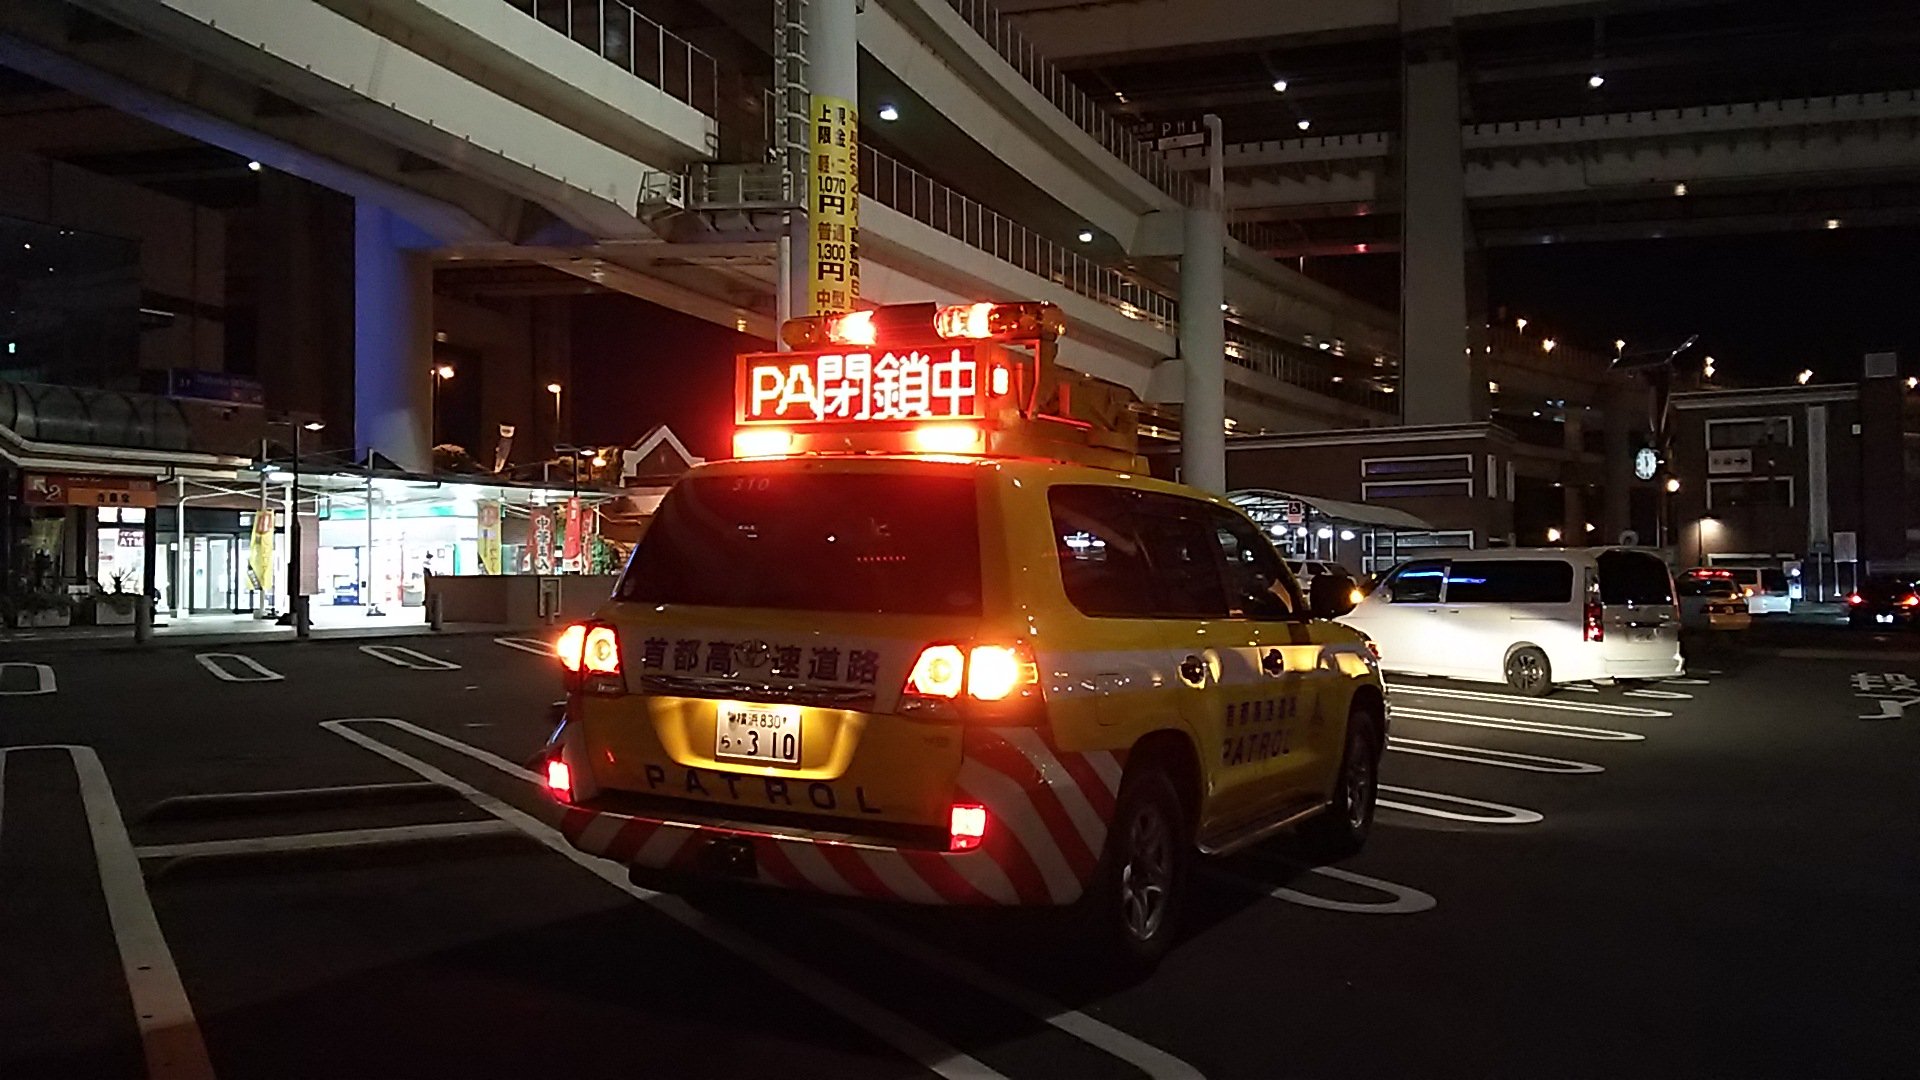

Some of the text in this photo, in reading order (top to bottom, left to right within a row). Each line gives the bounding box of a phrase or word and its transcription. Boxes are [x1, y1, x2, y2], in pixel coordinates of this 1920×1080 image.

[817, 103, 831, 145] 上限
[819, 195, 845, 216] 円
[817, 221, 845, 243] 普通
[818, 262, 844, 282] 円
[816, 289, 845, 309] 中型
[750, 348, 977, 421] PA閉鎖中
[732, 477, 770, 492] 310
[641, 637, 880, 685] 首都高速道路
[1222, 730, 1290, 765] PATROL
[644, 762, 883, 815] PATROL
